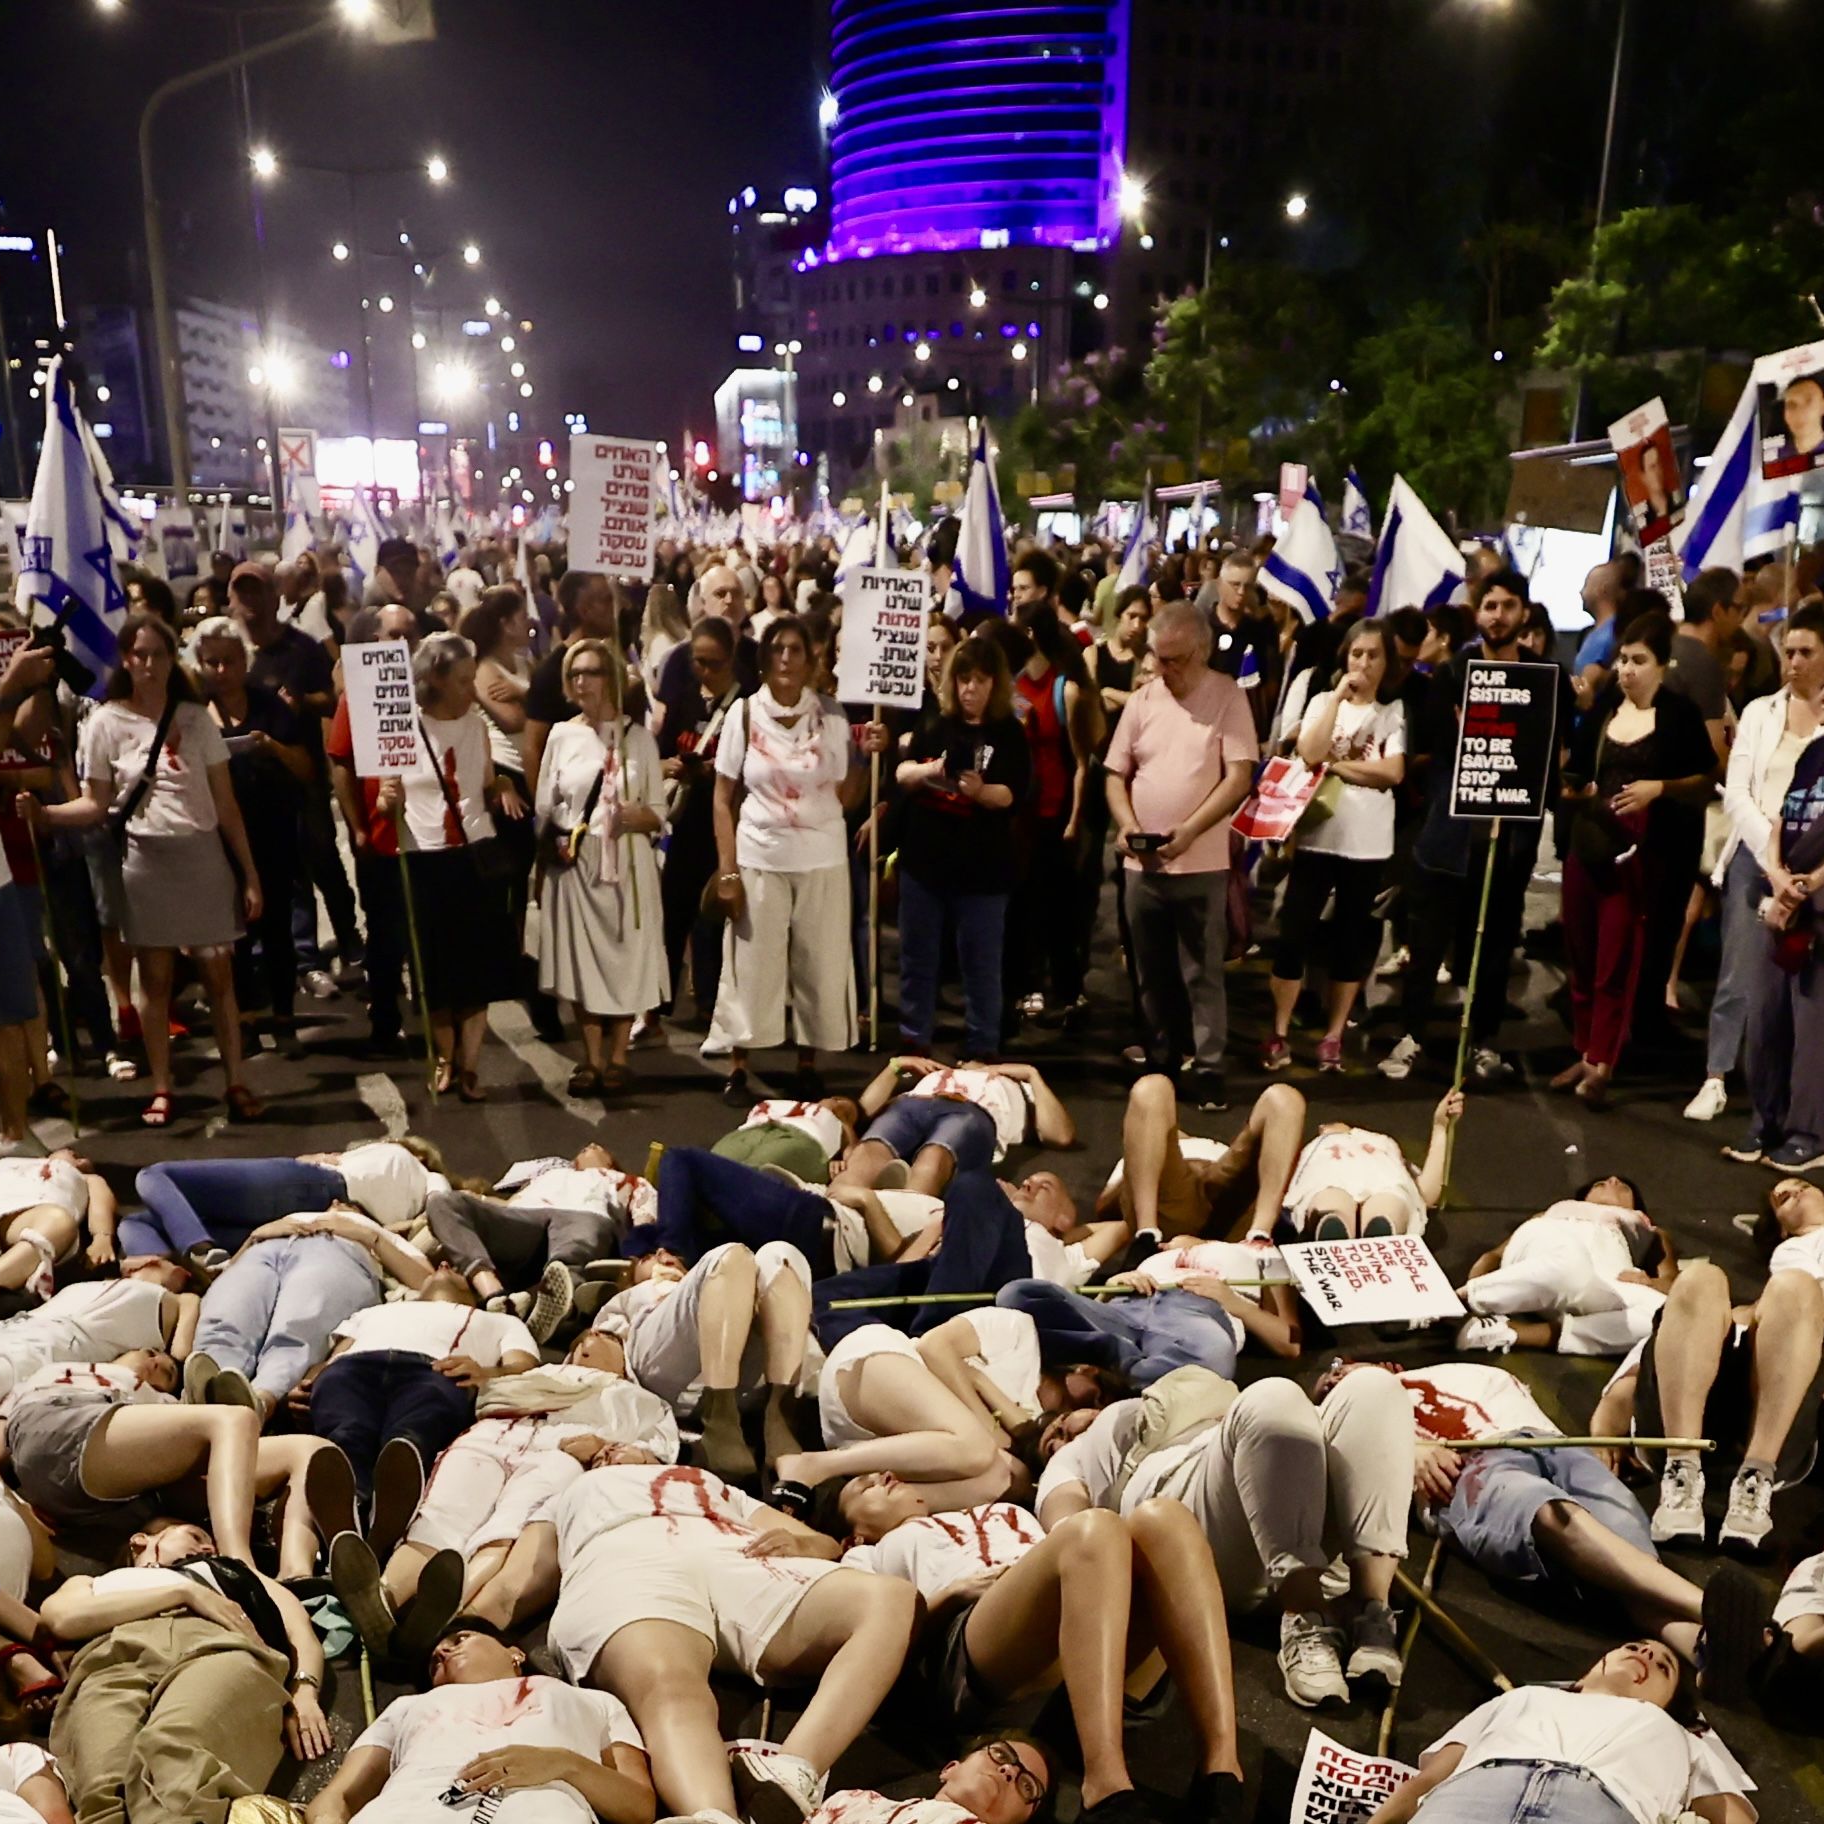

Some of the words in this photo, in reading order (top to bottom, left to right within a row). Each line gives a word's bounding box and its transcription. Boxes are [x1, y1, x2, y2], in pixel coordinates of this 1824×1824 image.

[861, 575, 922, 593] האחיות
[885, 594, 921, 610] שלנו
[877, 611, 920, 628] מתות
[872, 627, 919, 645] שנציל
[880, 646, 917, 662] אותן.
[869, 662, 916, 679] עסקה
[1471, 670, 1507, 686] OUR
[865, 680, 915, 696] עכשיו.
[1469, 687, 1531, 704] SISTERS
[1463, 737, 1487, 752] TO
[1490, 738, 1512, 754] BE
[1461, 753, 1518, 770] SAVED.
[1459, 770, 1500, 785] STOP
[1458, 787, 1492, 802] THE
[1496, 788, 1531, 804] WAR.
[1373, 1241, 1398, 1267] ARE
[1403, 1238, 1428, 1268] OUR
[1300, 1248, 1322, 1276] THE
[1314, 1247, 1342, 1279] STOP
[1329, 1245, 1364, 1293] SAVED.
[1344, 1245, 1363, 1261] TO
[1358, 1265, 1376, 1283] BE
[1359, 1243, 1393, 1285] DYING
[1388, 1240, 1429, 1293] PEOPLE
